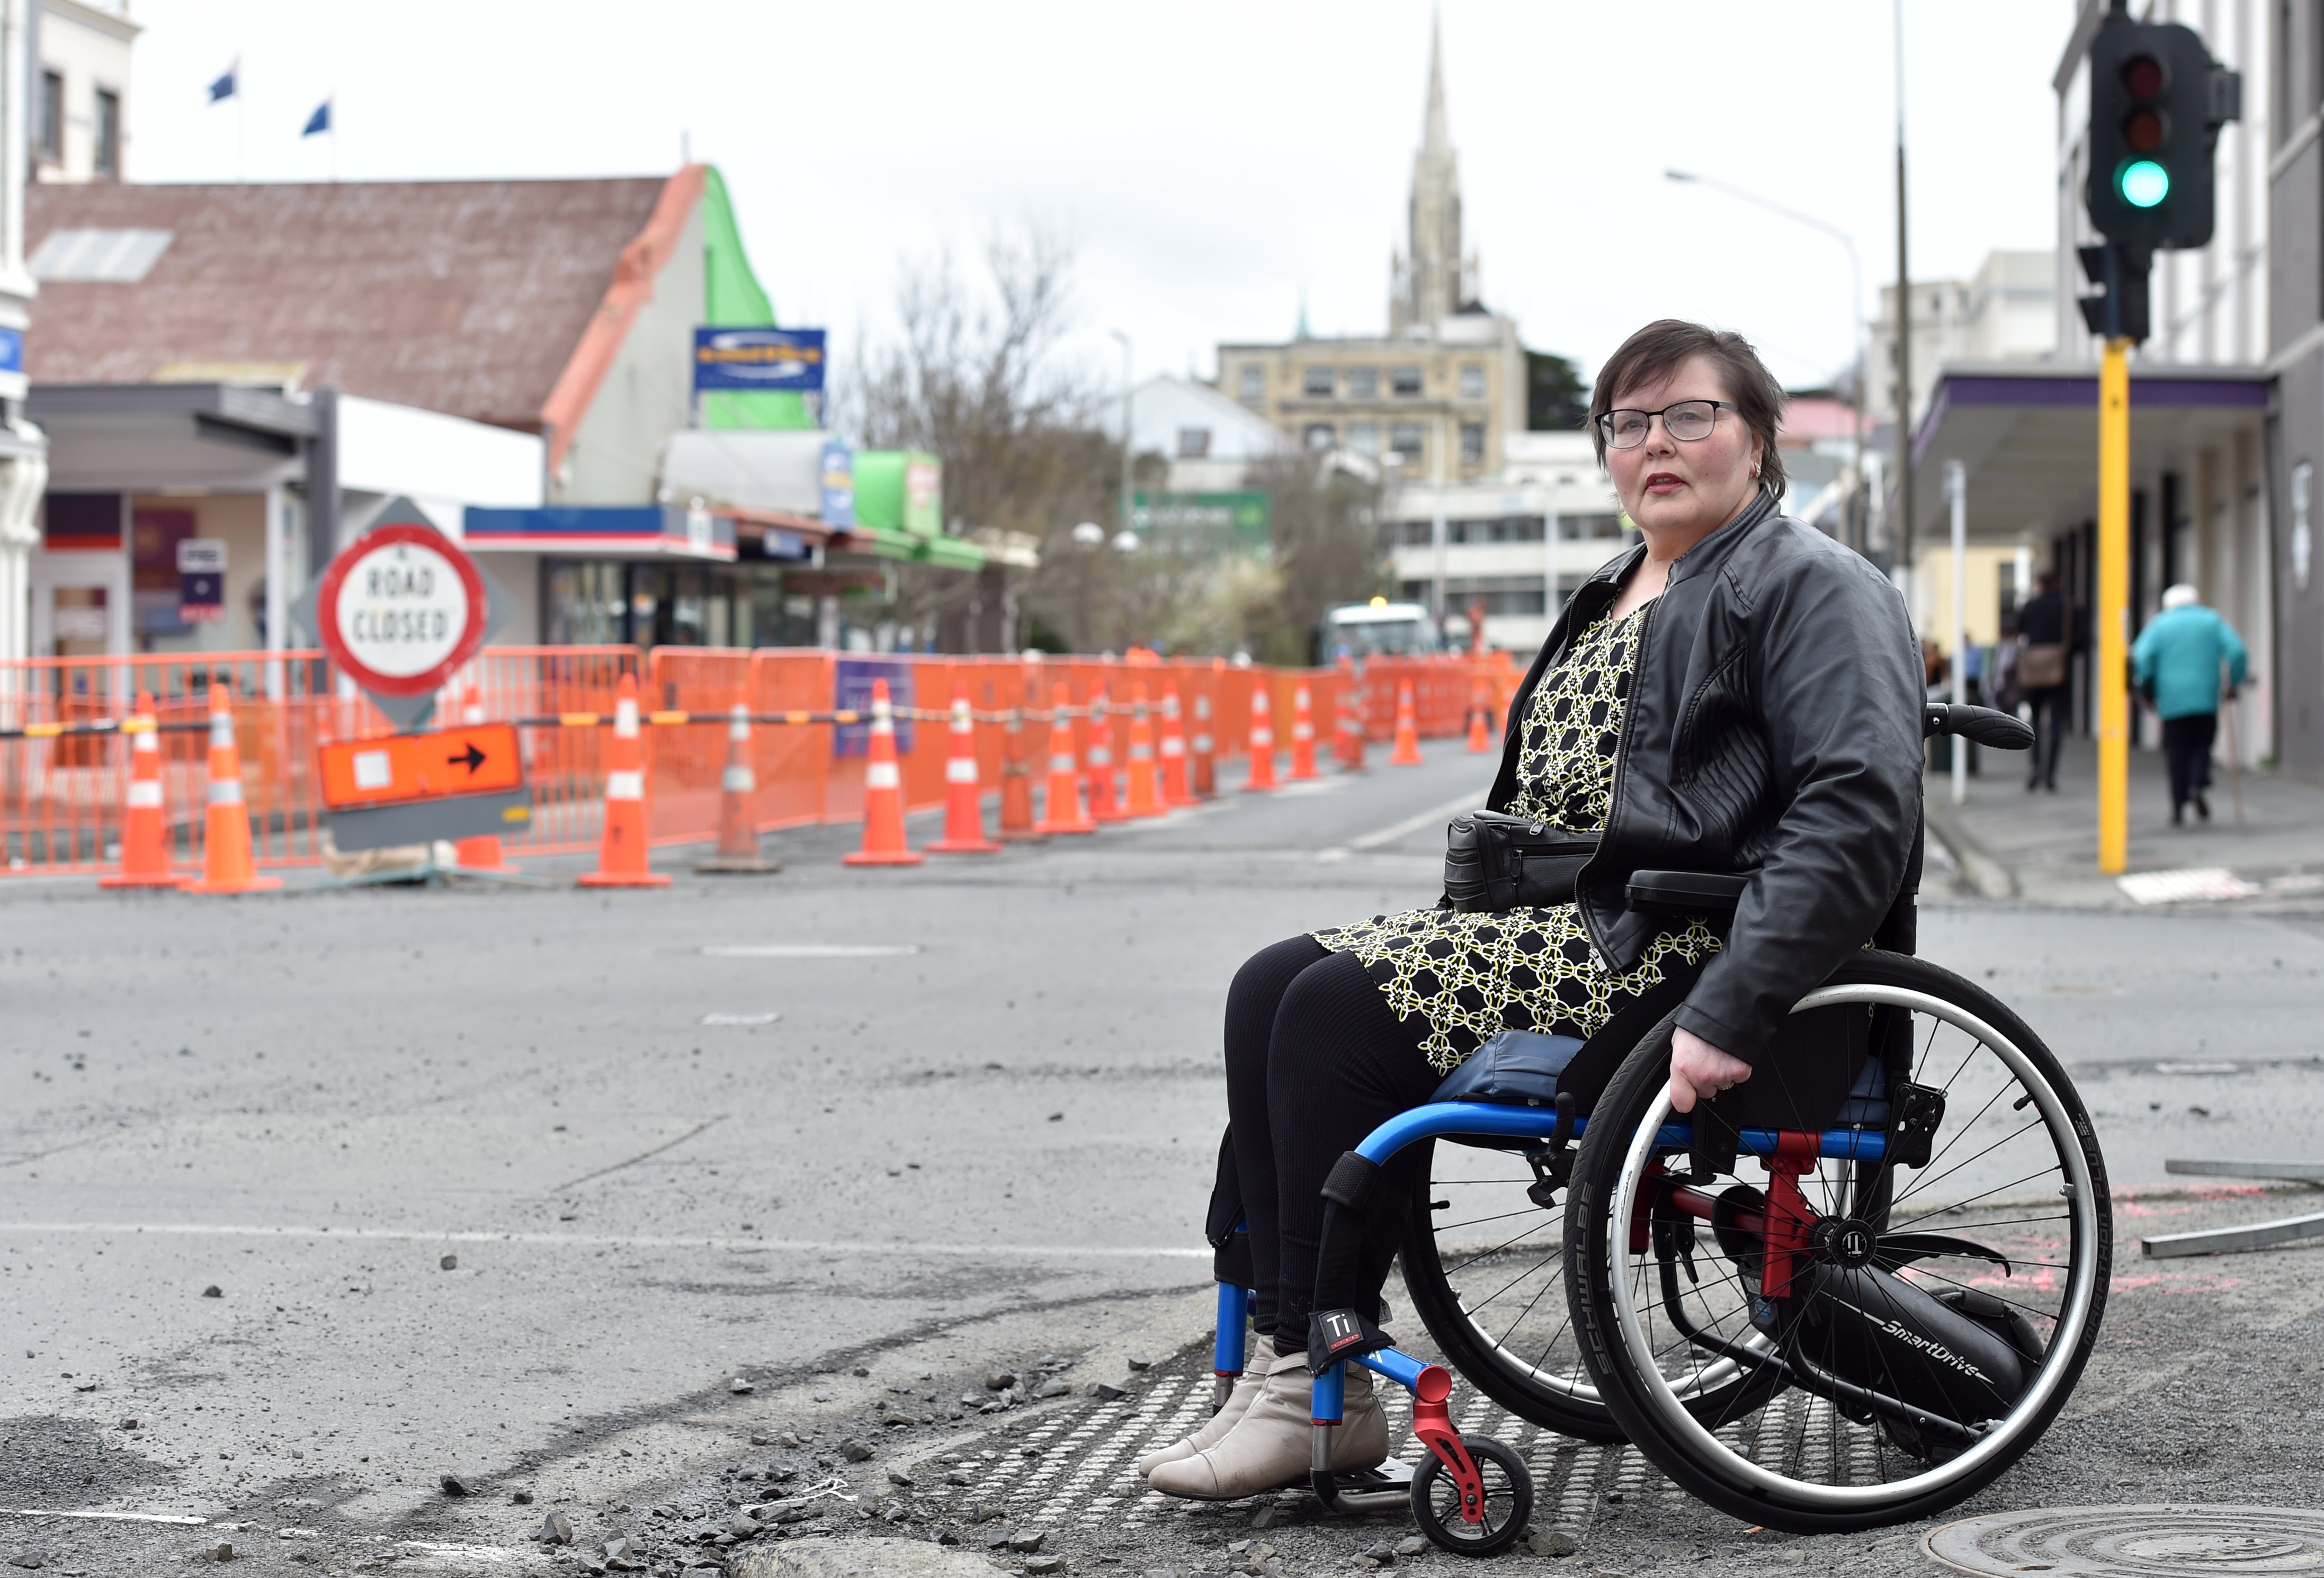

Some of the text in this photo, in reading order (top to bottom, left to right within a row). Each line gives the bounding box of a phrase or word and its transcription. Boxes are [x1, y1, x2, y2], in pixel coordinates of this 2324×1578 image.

[367, 566, 435, 598] ROAD
[353, 608, 449, 642] CLOSED
[2083, 1137, 2105, 1199] PLUS
[1847, 1235, 1862, 1255] Ti
[1576, 1181, 1613, 1375] SCHWALBE
[1327, 1313, 1351, 1338] Ti
[1882, 1320, 1979, 1376] SmartDrive
